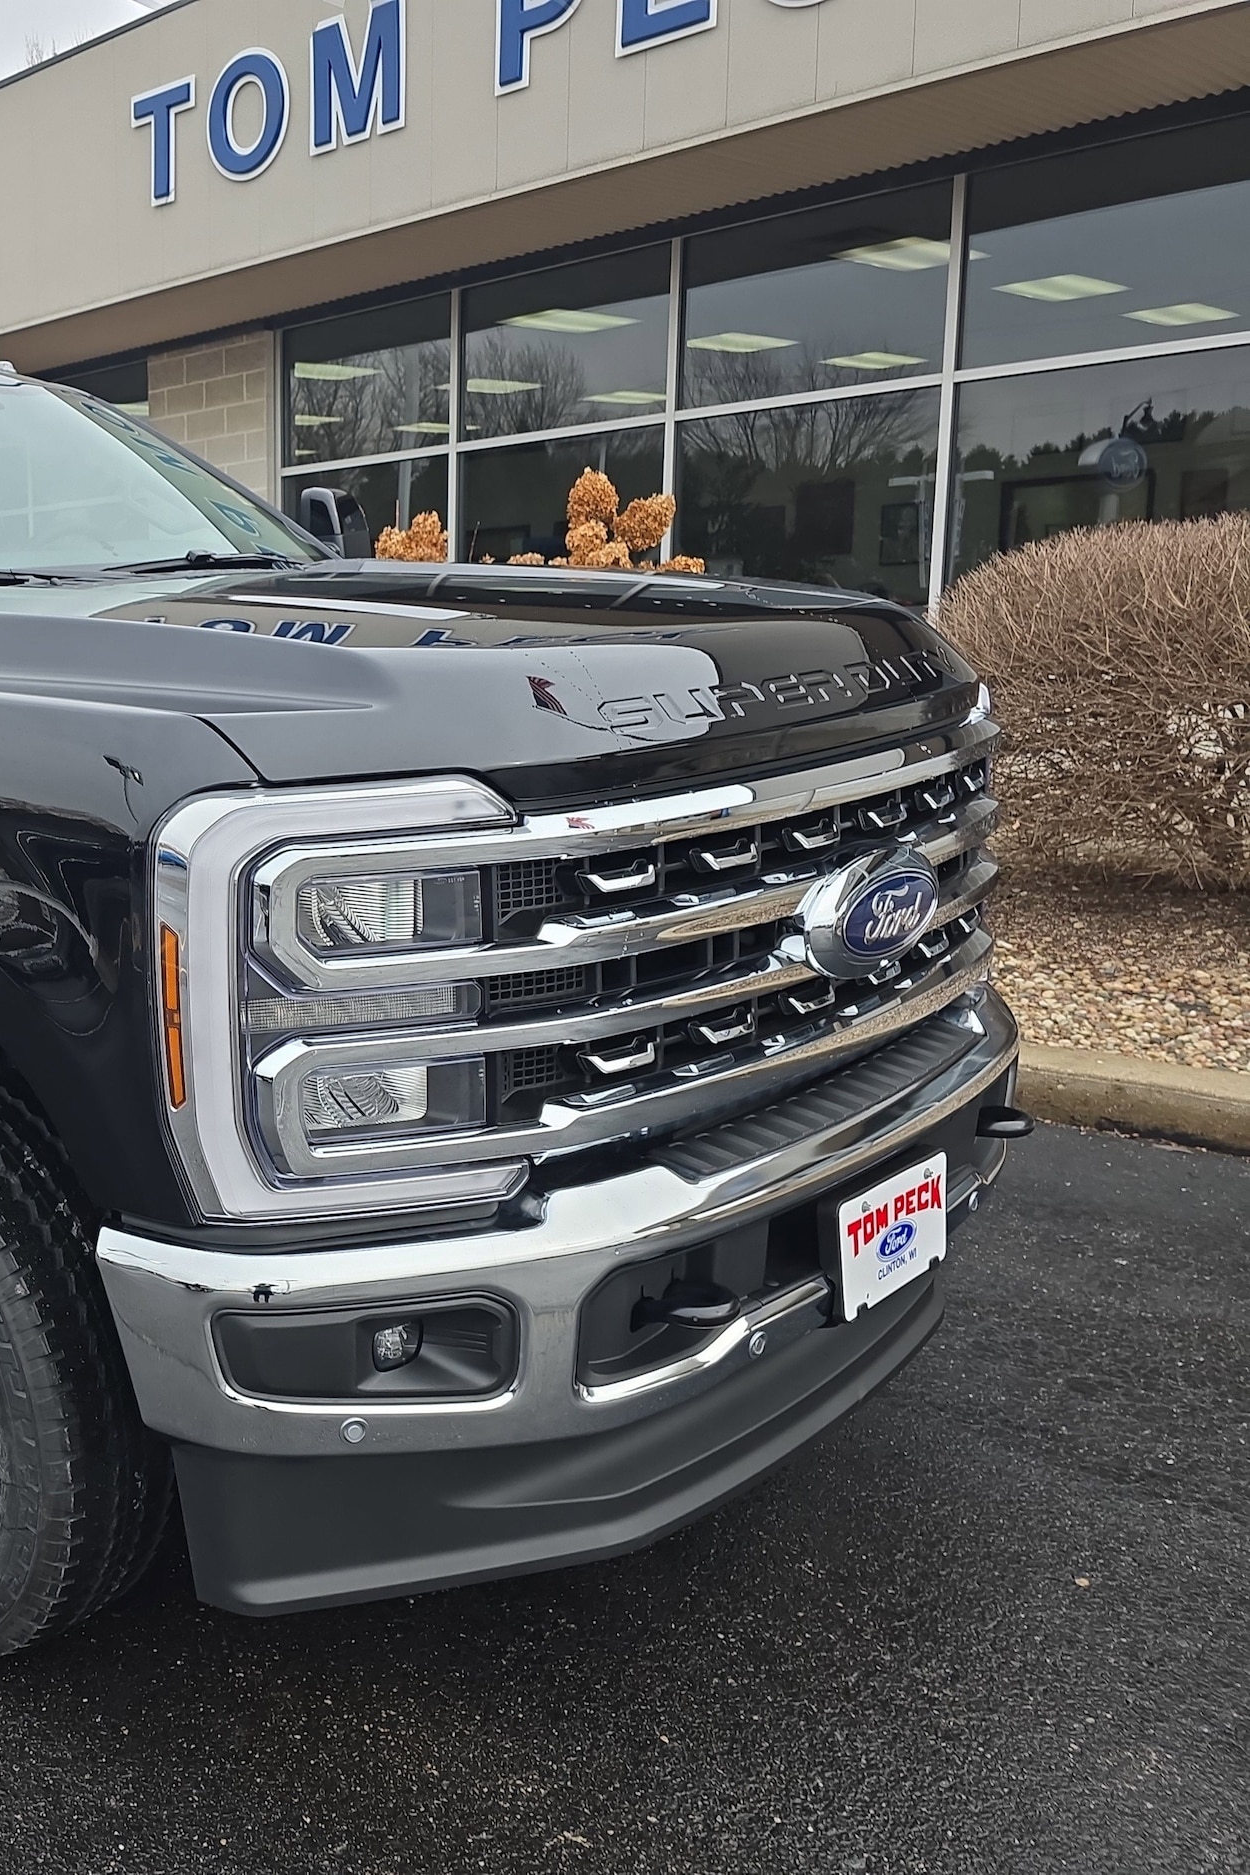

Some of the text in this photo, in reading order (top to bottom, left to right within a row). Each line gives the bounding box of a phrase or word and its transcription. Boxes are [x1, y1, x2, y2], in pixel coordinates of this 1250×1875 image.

[131, 0, 407, 207] TOM
[597, 668, 853, 735] SUPER
[863, 884, 923, 946] Ford
[847, 1174, 942, 1258] TOM PECK
[884, 1226, 909, 1256] Ford
[878, 1248, 917, 1280] CLINTON, WI
